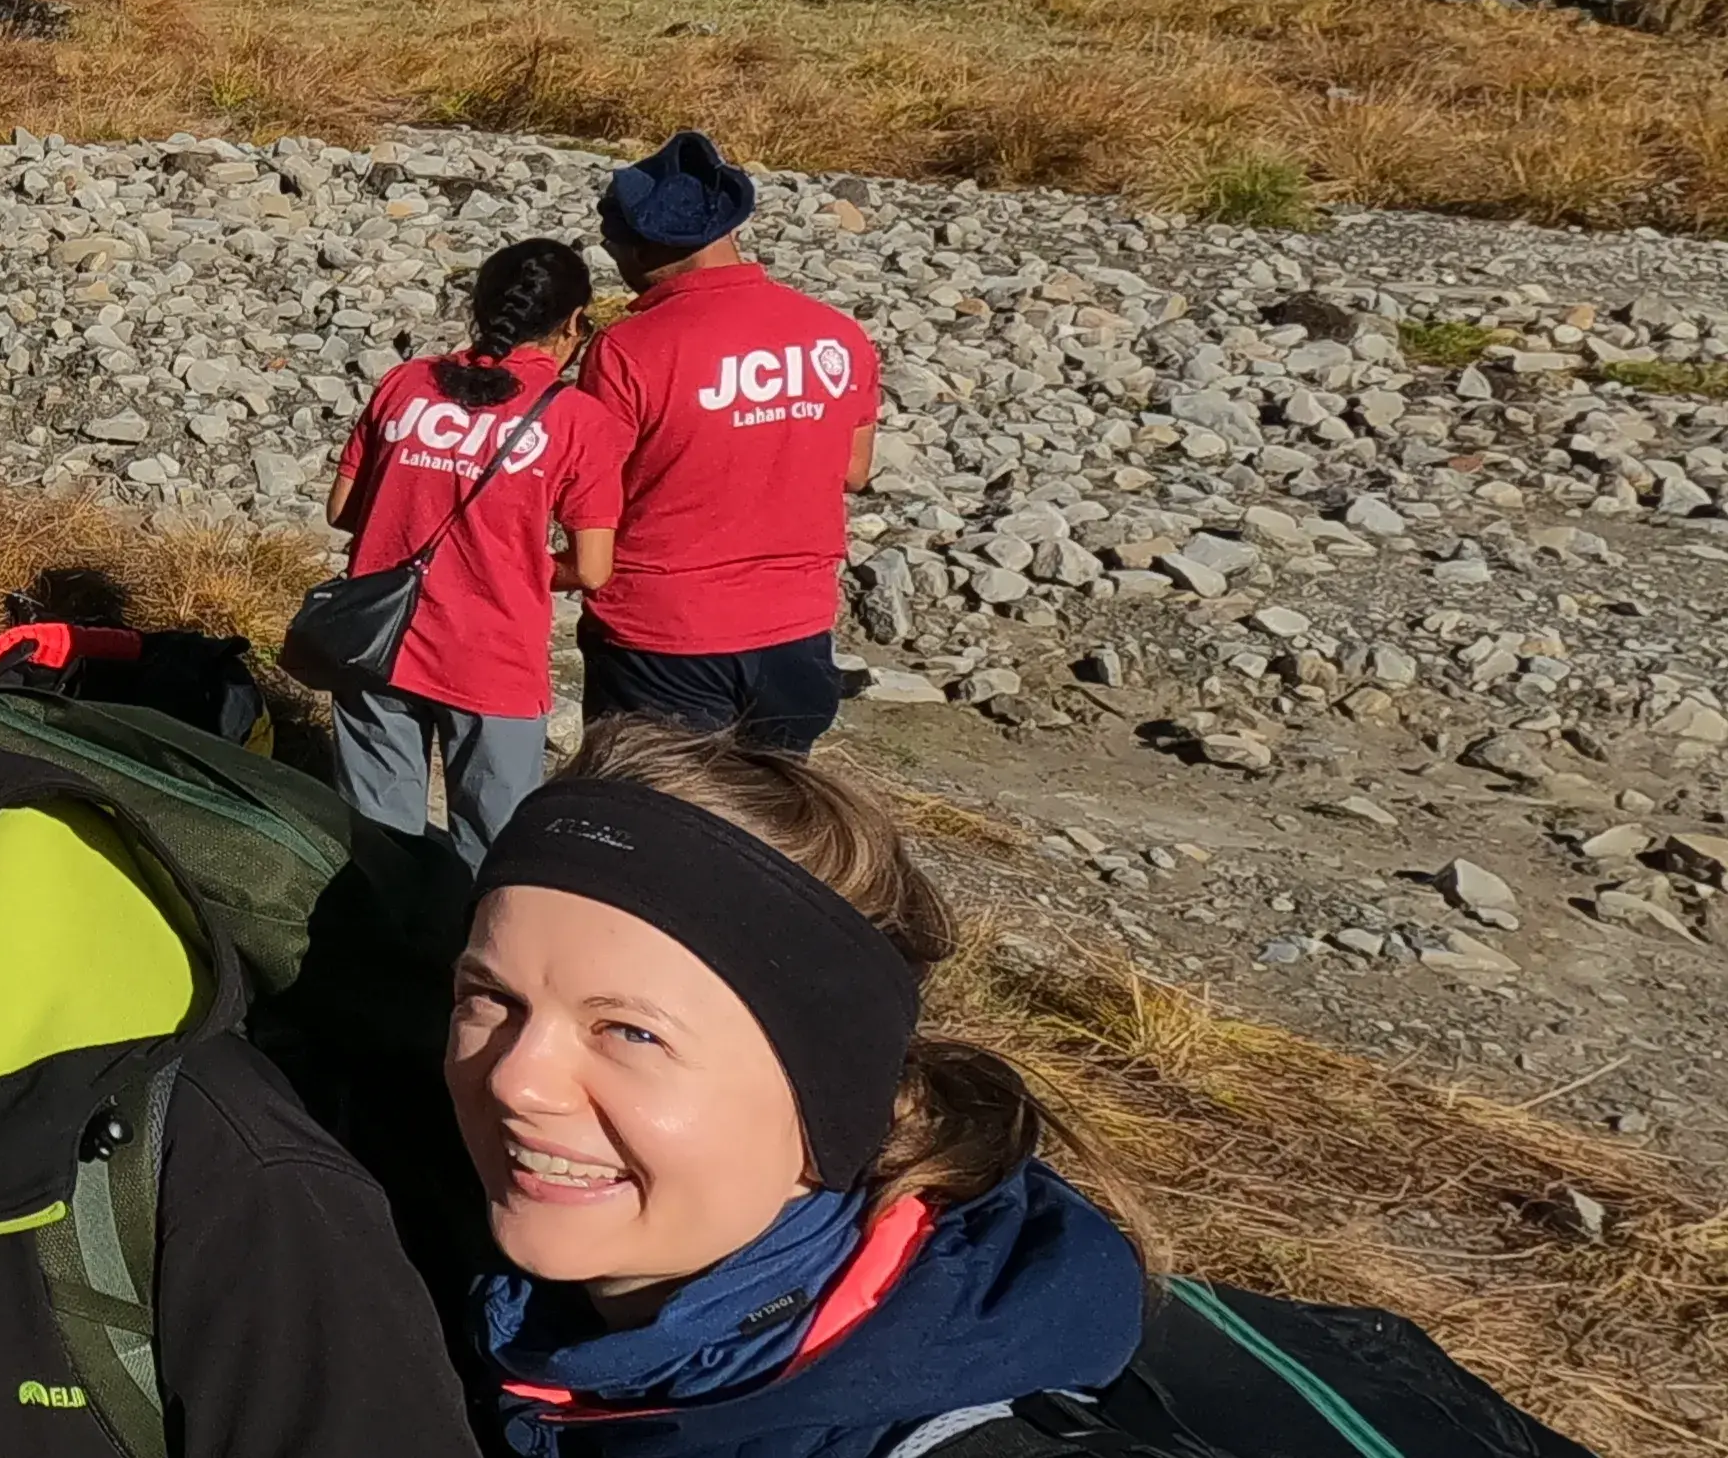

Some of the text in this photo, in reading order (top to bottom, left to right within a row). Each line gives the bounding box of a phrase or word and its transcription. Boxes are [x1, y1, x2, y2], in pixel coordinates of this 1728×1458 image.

[698, 346, 804, 411] JCI
[384, 397, 497, 457] JCI
[732, 400, 825, 428] Lahan City
[398, 447, 485, 481] Lahan Cit
